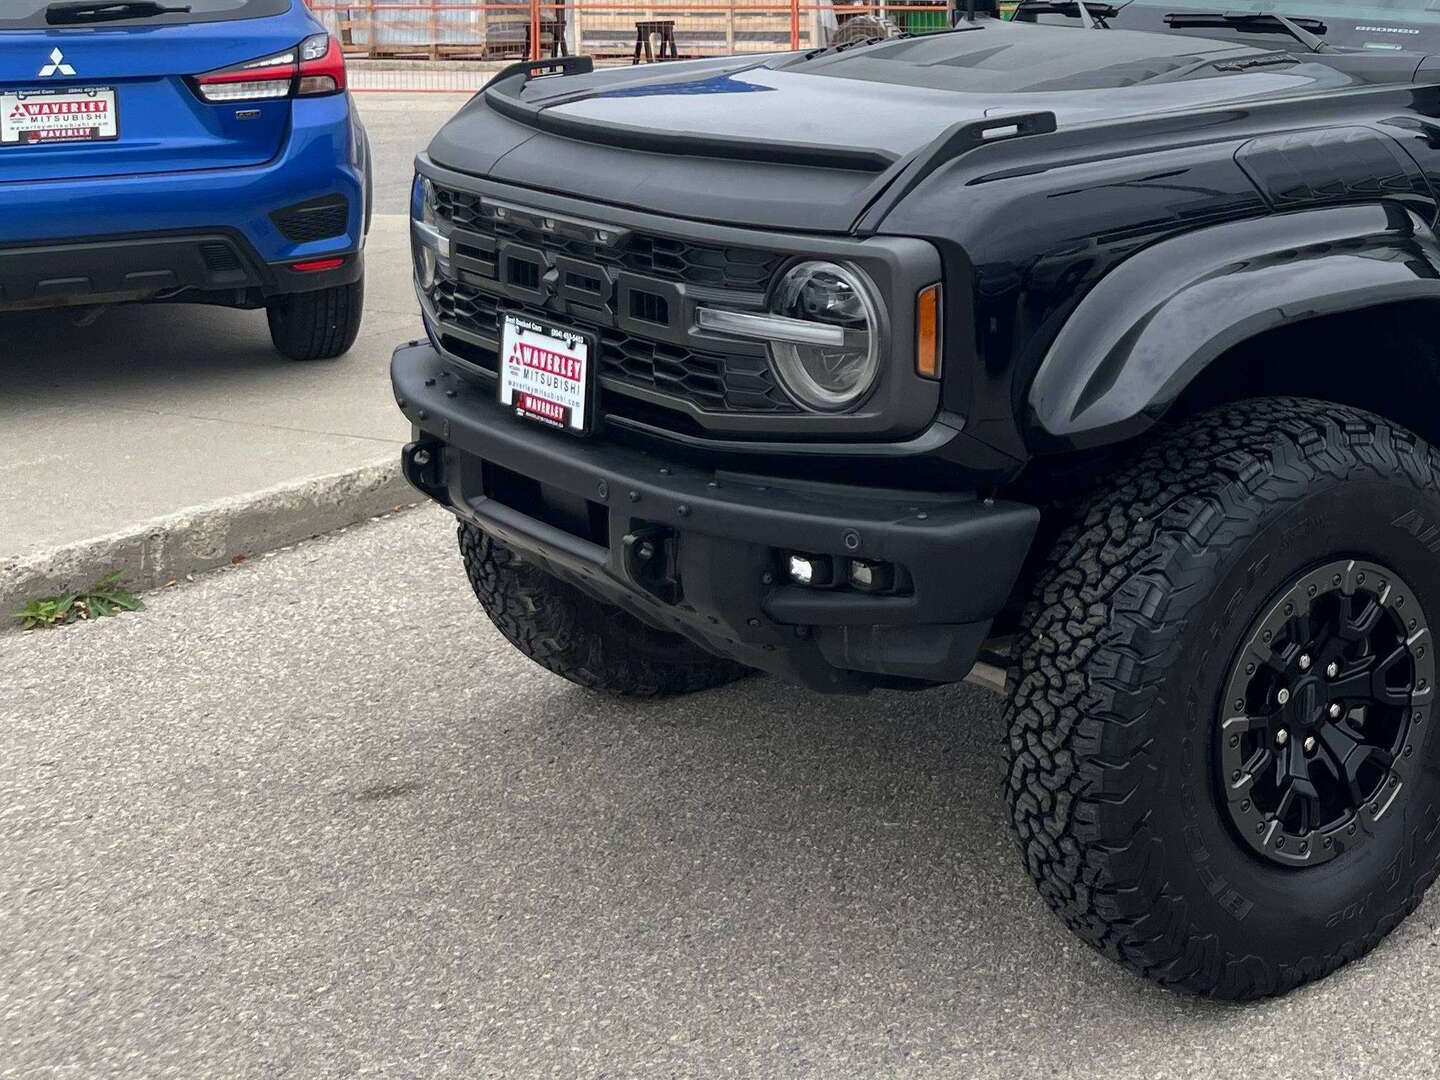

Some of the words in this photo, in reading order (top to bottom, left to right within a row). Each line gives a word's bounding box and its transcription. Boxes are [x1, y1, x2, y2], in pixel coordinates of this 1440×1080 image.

[28, 101, 106, 115] WAVERLEY
[30, 113, 107, 123] MITSUBISHI
[40, 128, 91, 138] WAVERLEY
[522, 345, 582, 380] WAVERLEY
[523, 368, 581, 396] MITSUBISHI
[525, 396, 564, 419] WAVERLEY
